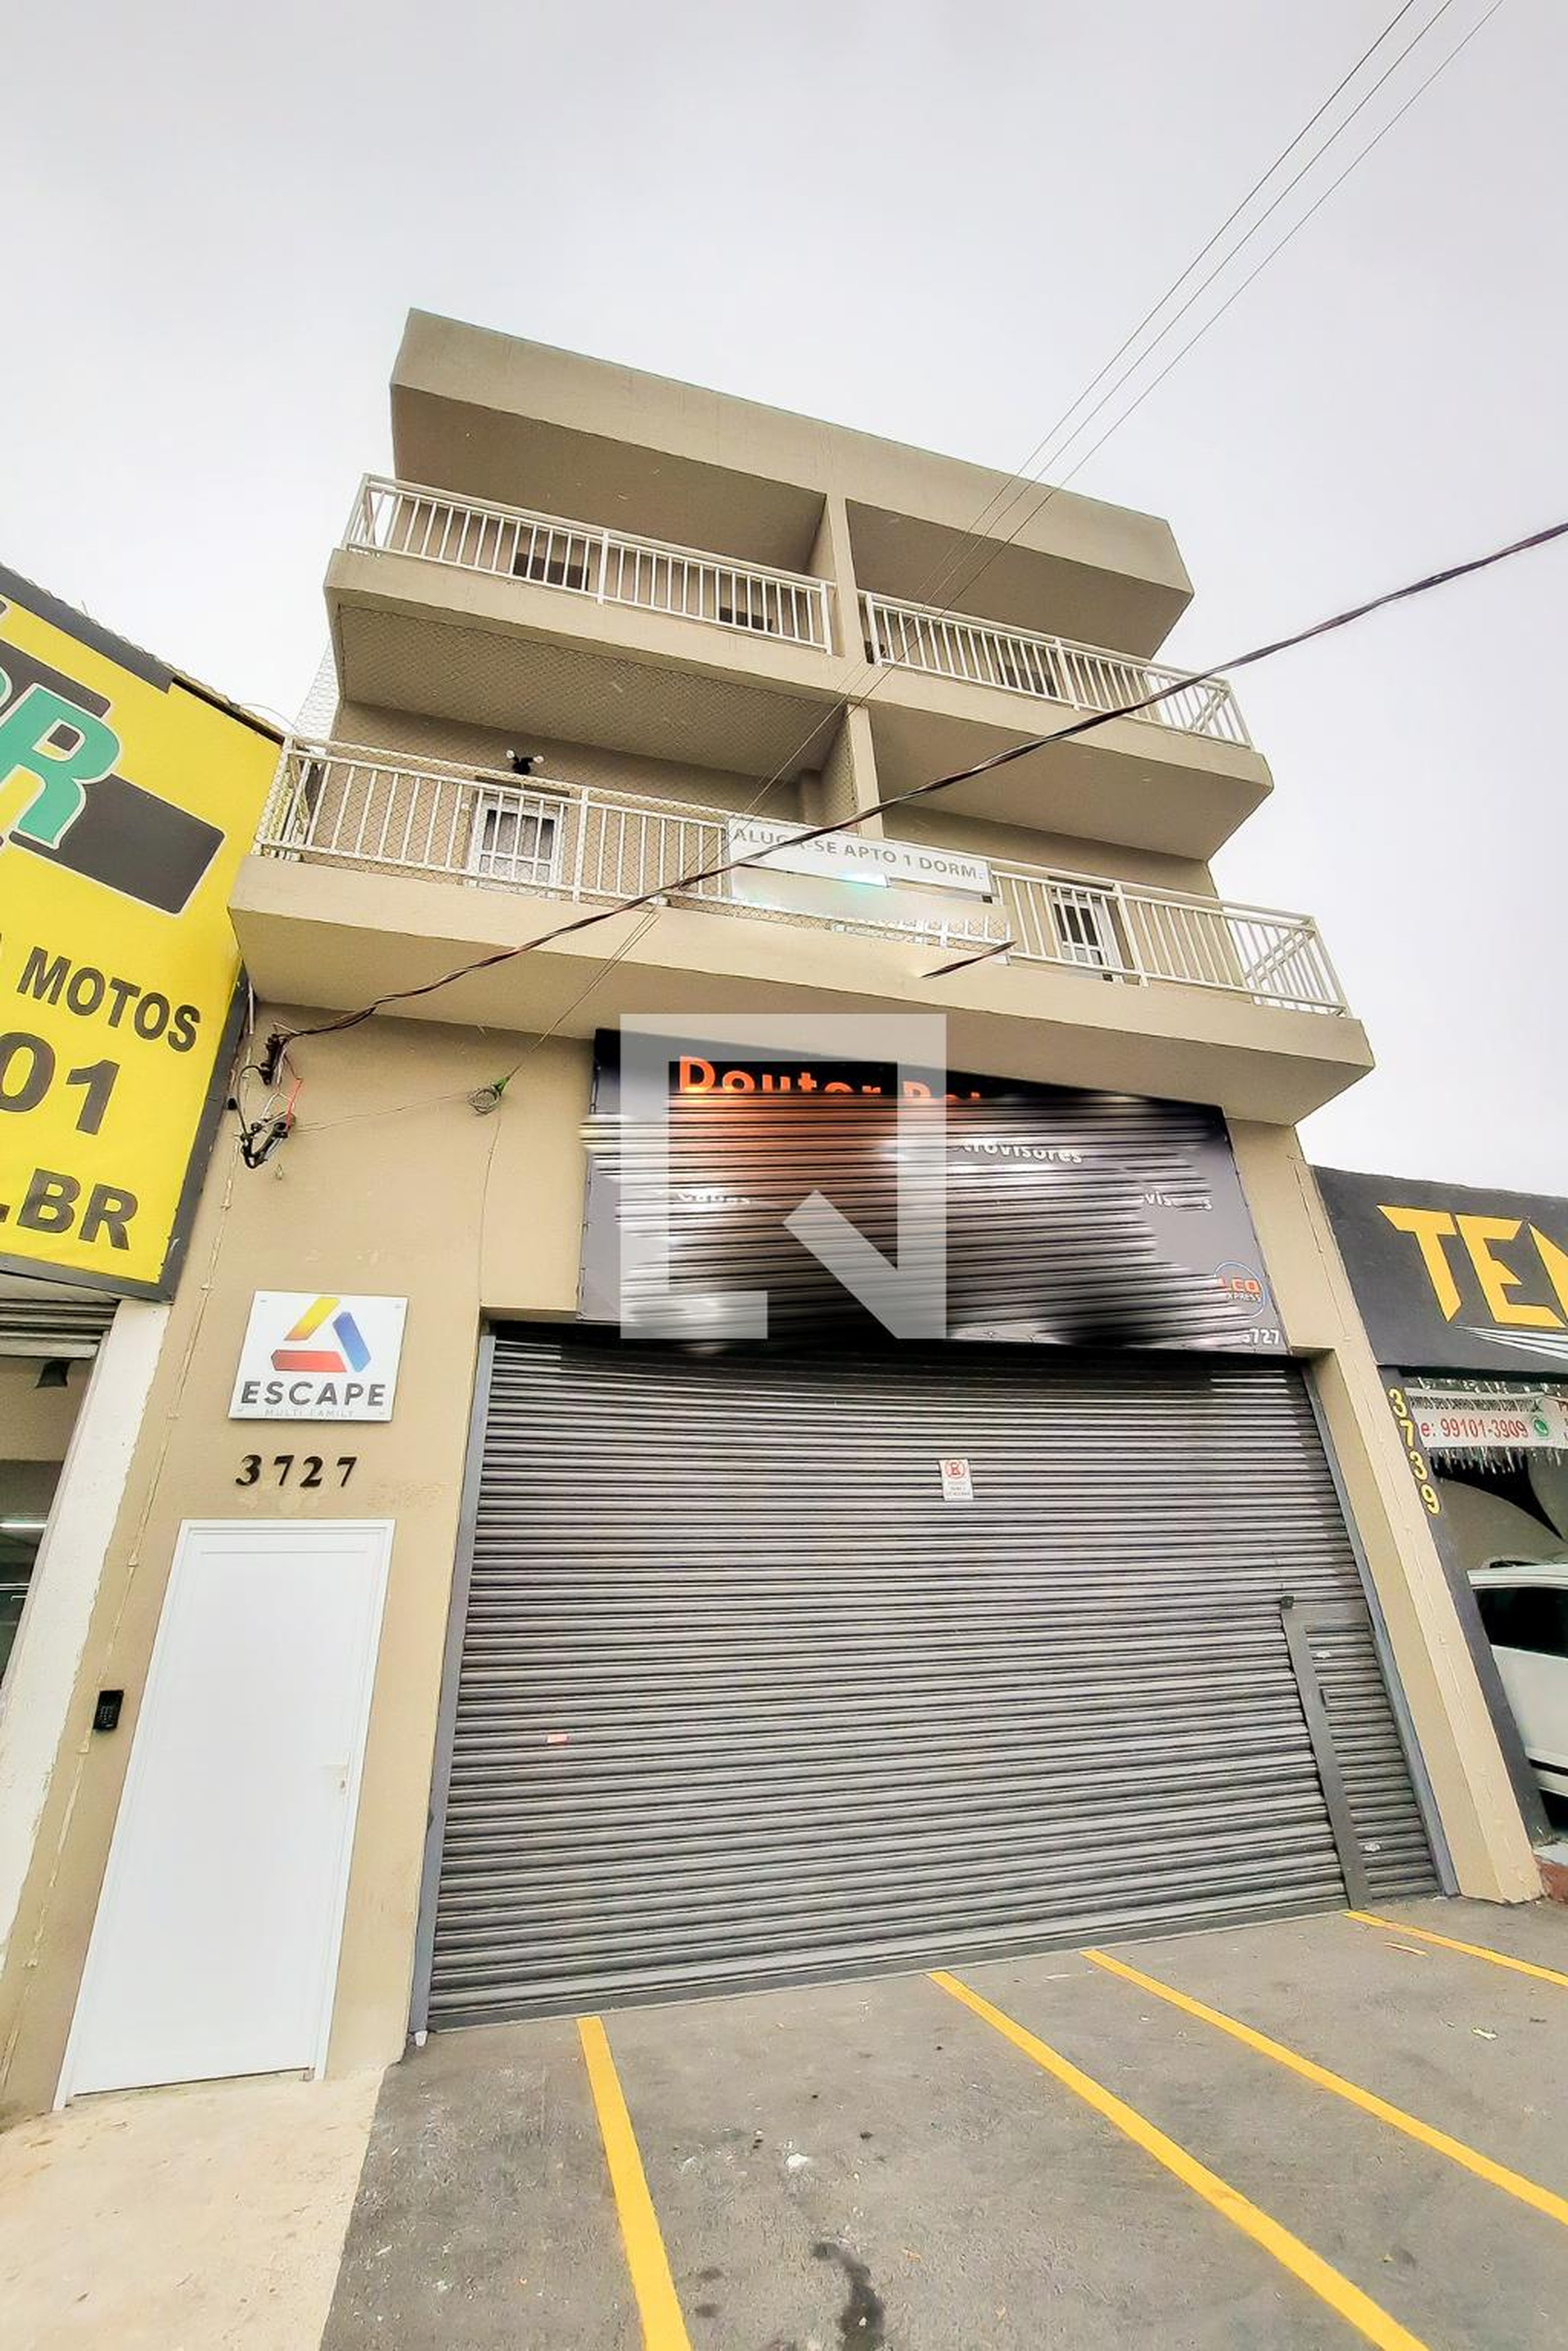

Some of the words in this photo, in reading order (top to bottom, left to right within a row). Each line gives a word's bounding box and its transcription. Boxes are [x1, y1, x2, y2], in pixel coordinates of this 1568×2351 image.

[844, 845, 896, 863] APTO
[904, 854, 910, 866] 1
[16, 946, 201, 1053] MOTOS
[241, 1381, 385, 1406] ESCAPE
[1441, 1418, 1529, 1439] 99101-3909
[1388, 1388, 1440, 1514] 3739
[236, 1454, 357, 1488] 3727
